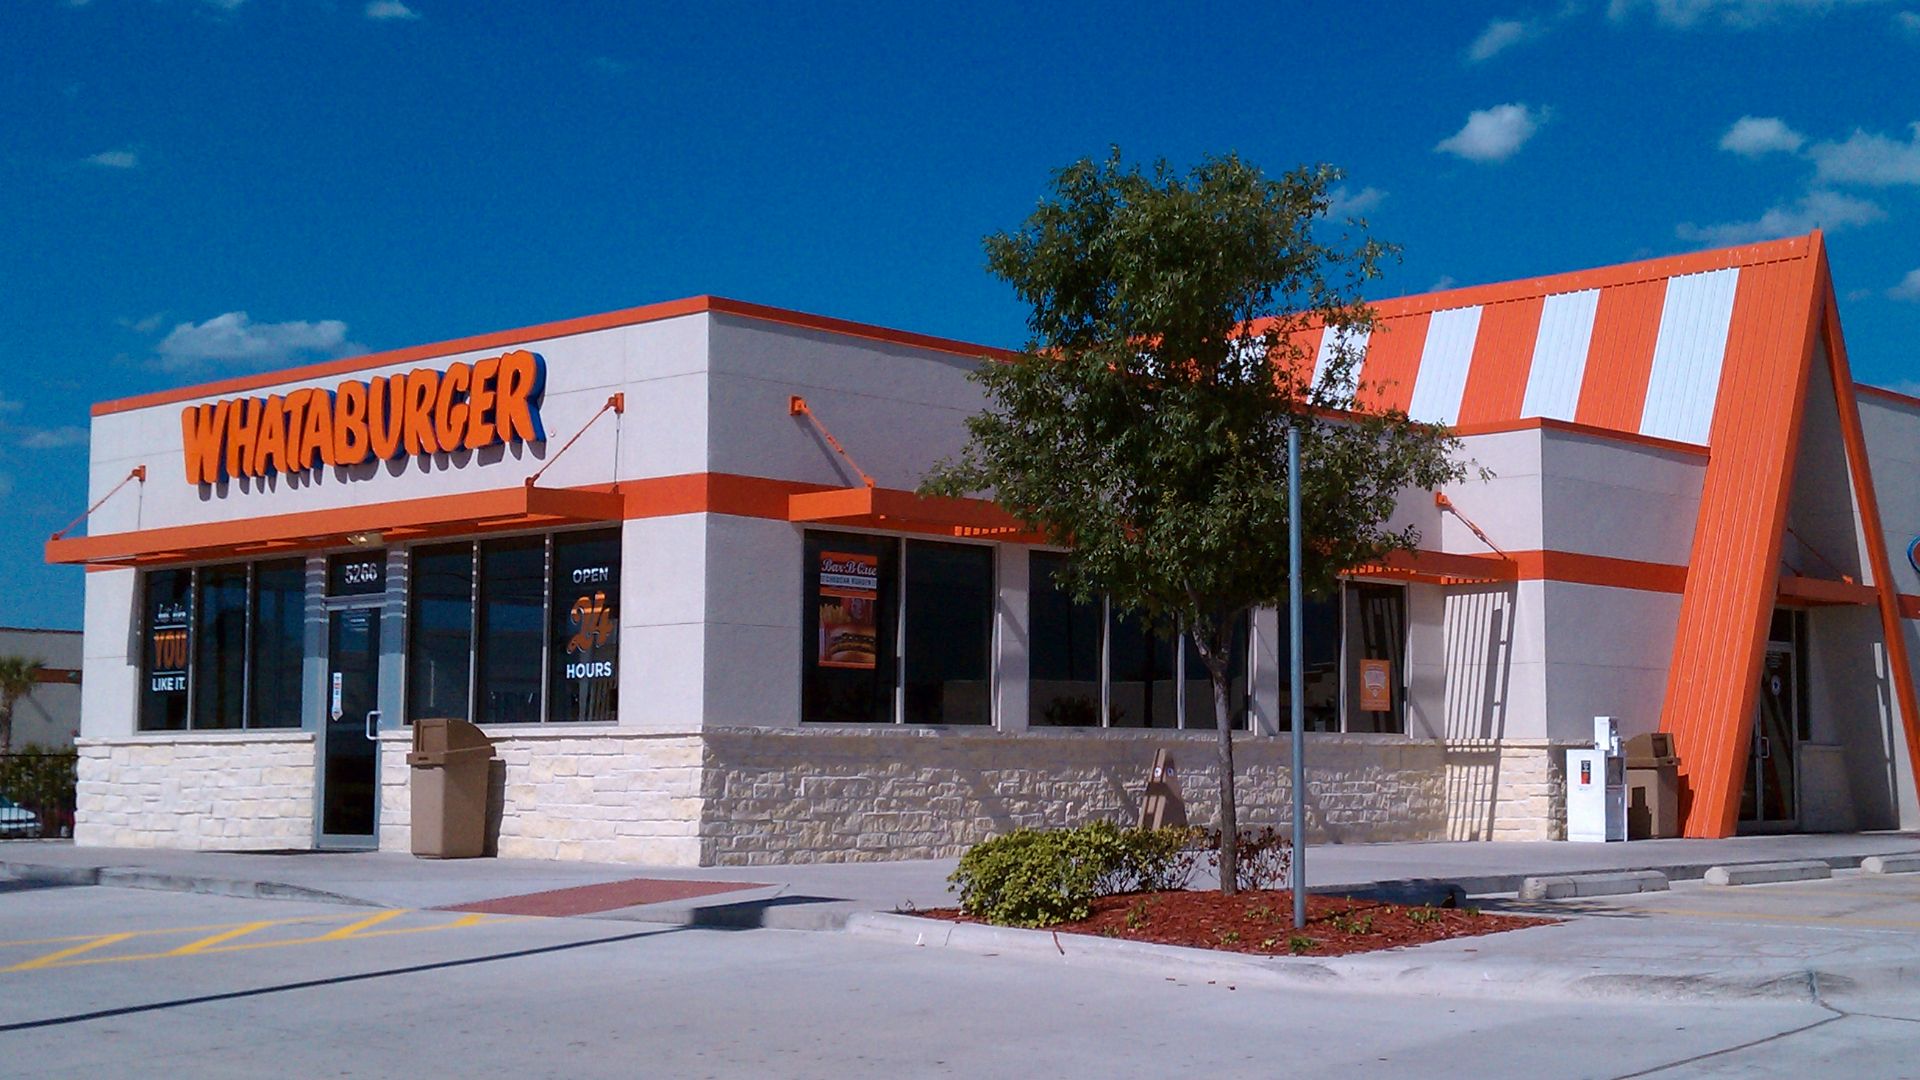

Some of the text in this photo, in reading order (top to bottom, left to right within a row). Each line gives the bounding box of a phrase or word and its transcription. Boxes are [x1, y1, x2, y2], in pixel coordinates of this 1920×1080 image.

[182, 350, 545, 485] WHATABURGER
[345, 563, 378, 584] 5266
[573, 567, 609, 584] OPEN
[566, 591, 613, 654] 24
[154, 631, 187, 670] YOU
[566, 661, 612, 679] HOURS
[152, 677, 174, 692] LIKE
